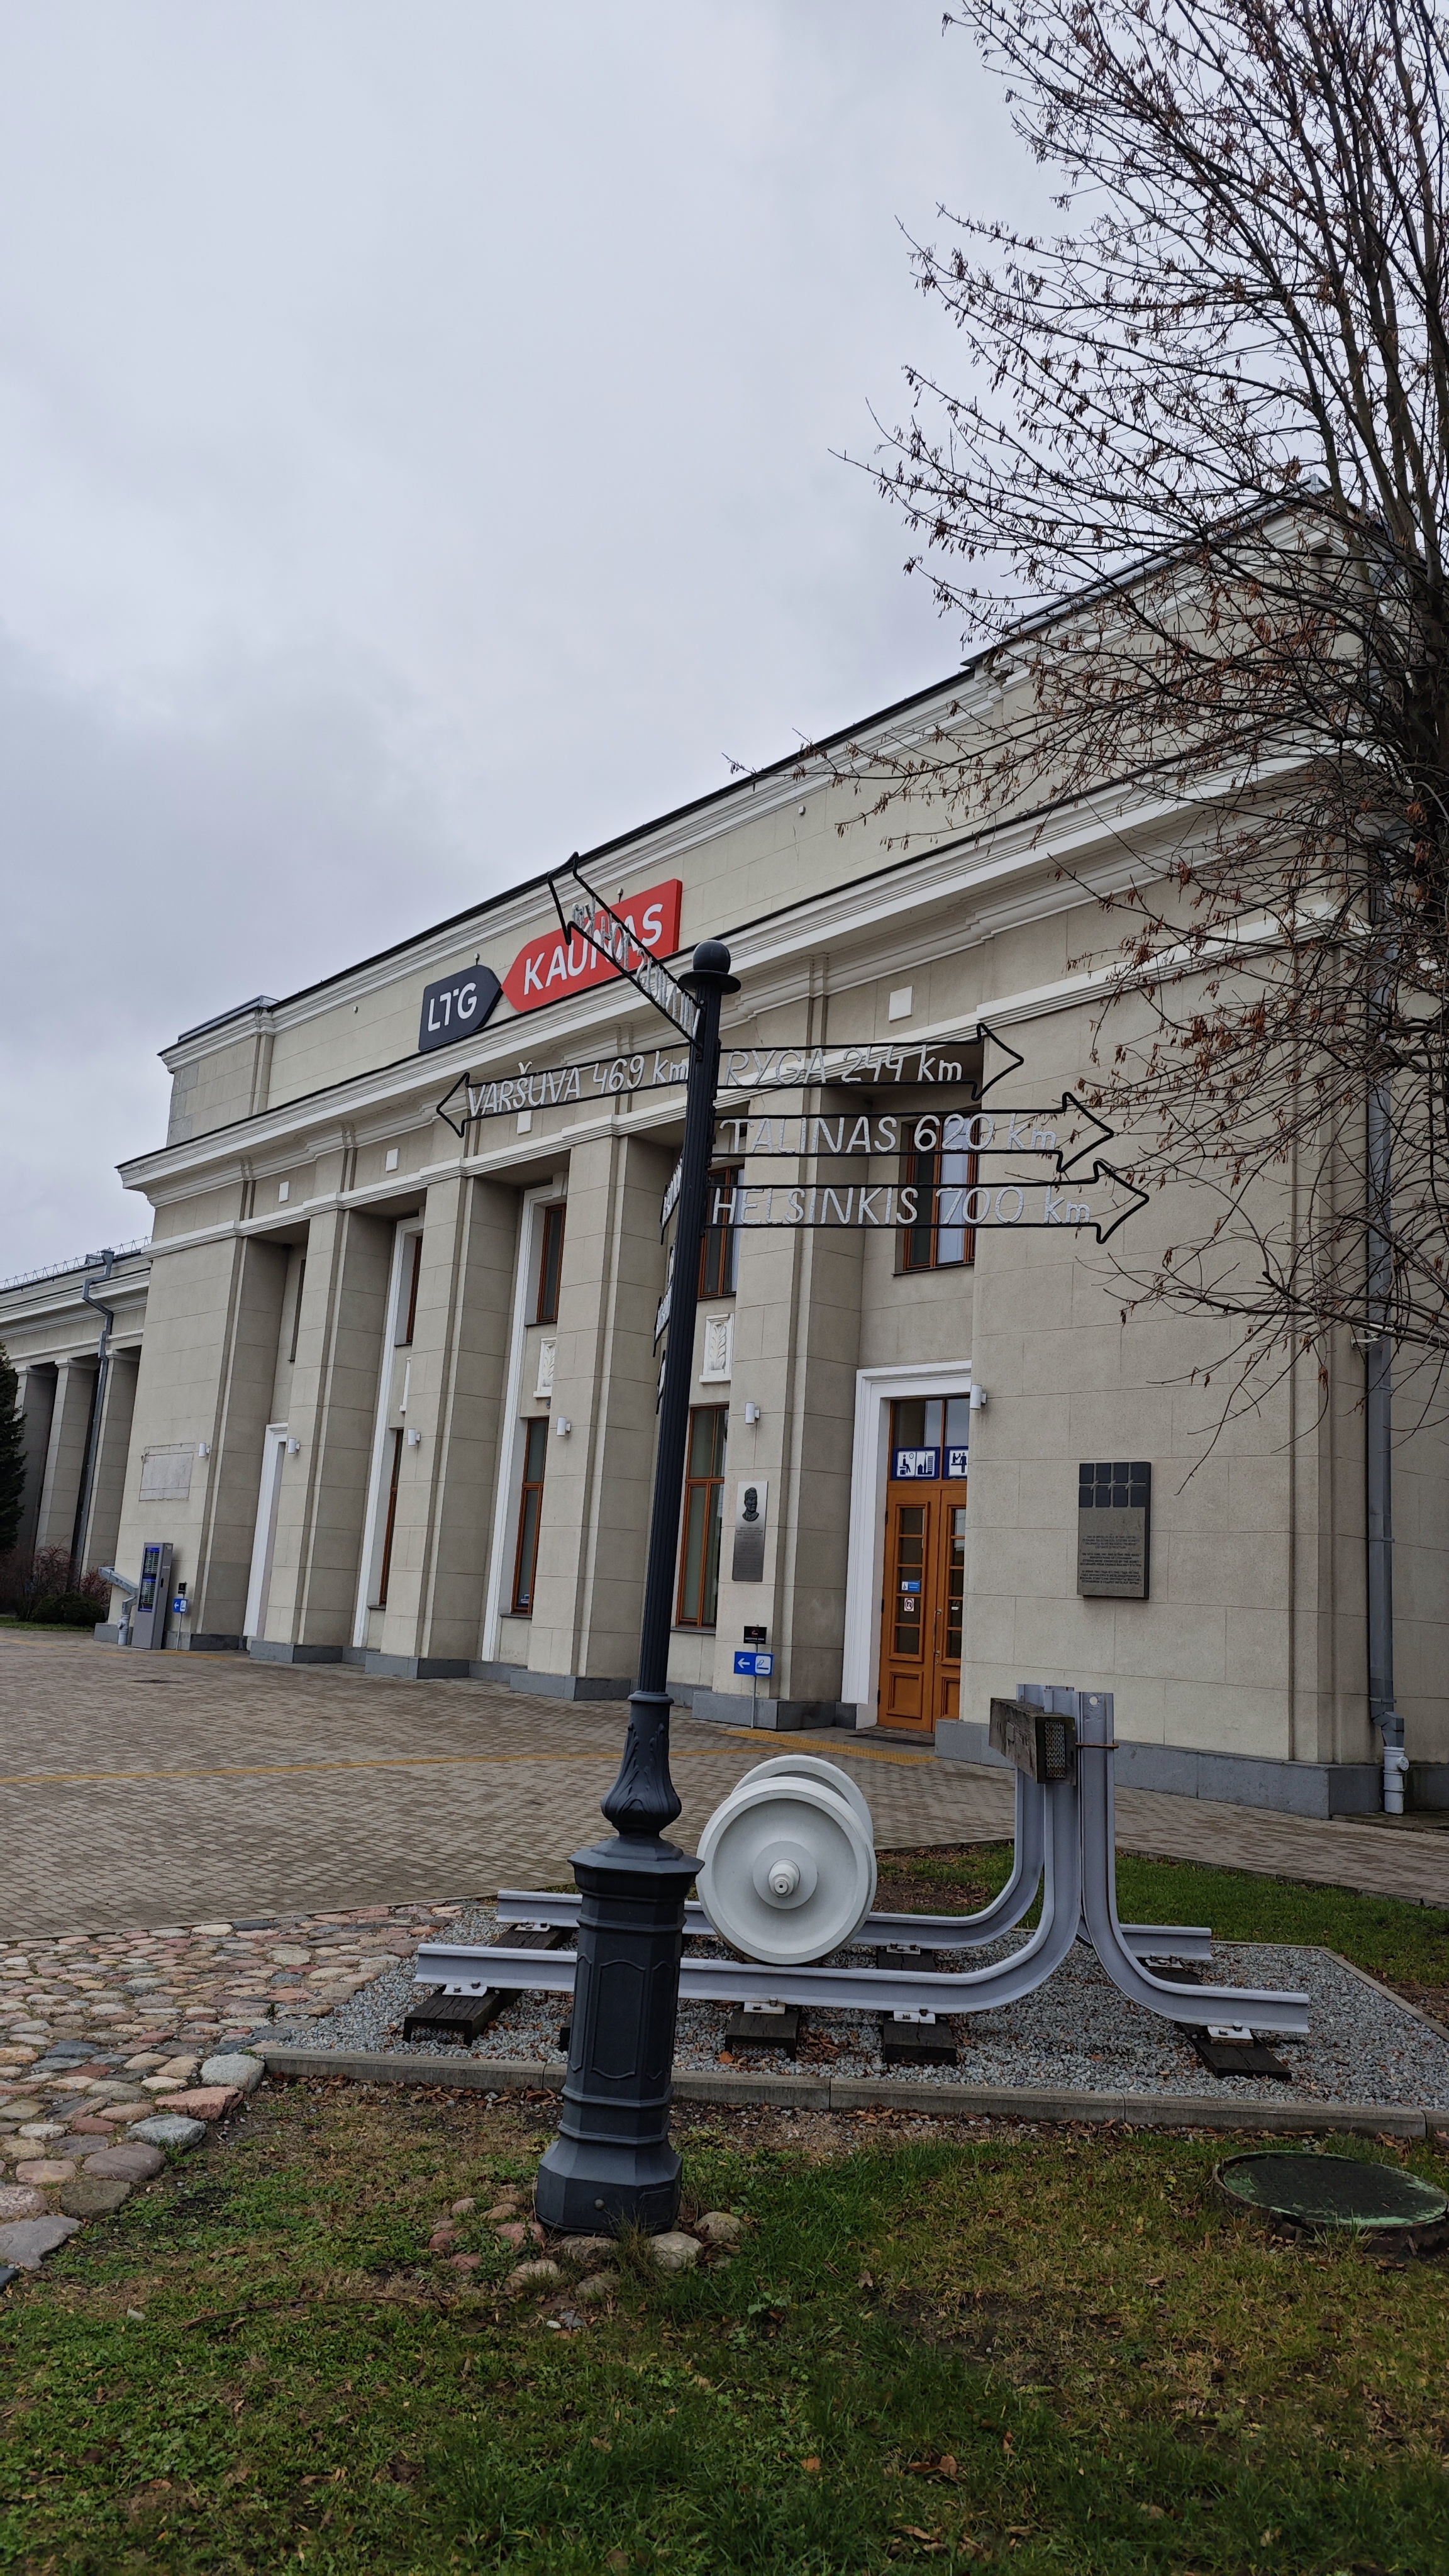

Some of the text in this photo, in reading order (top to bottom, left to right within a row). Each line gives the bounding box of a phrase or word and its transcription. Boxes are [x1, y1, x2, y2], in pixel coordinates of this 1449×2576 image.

[524, 903, 663, 996] KAUNAS
[428, 982, 477, 1032] LTG
[468, 1051, 688, 1117] VARŠUVA 469 km
[724, 1045, 962, 1085] RYGA 244 km
[719, 1113, 1057, 1153] TALINAS 620 km
[712, 1187, 919, 1224] HELSINKIS
[935, 1186, 1024, 1224] 700
[1043, 1185, 1091, 1224] km
